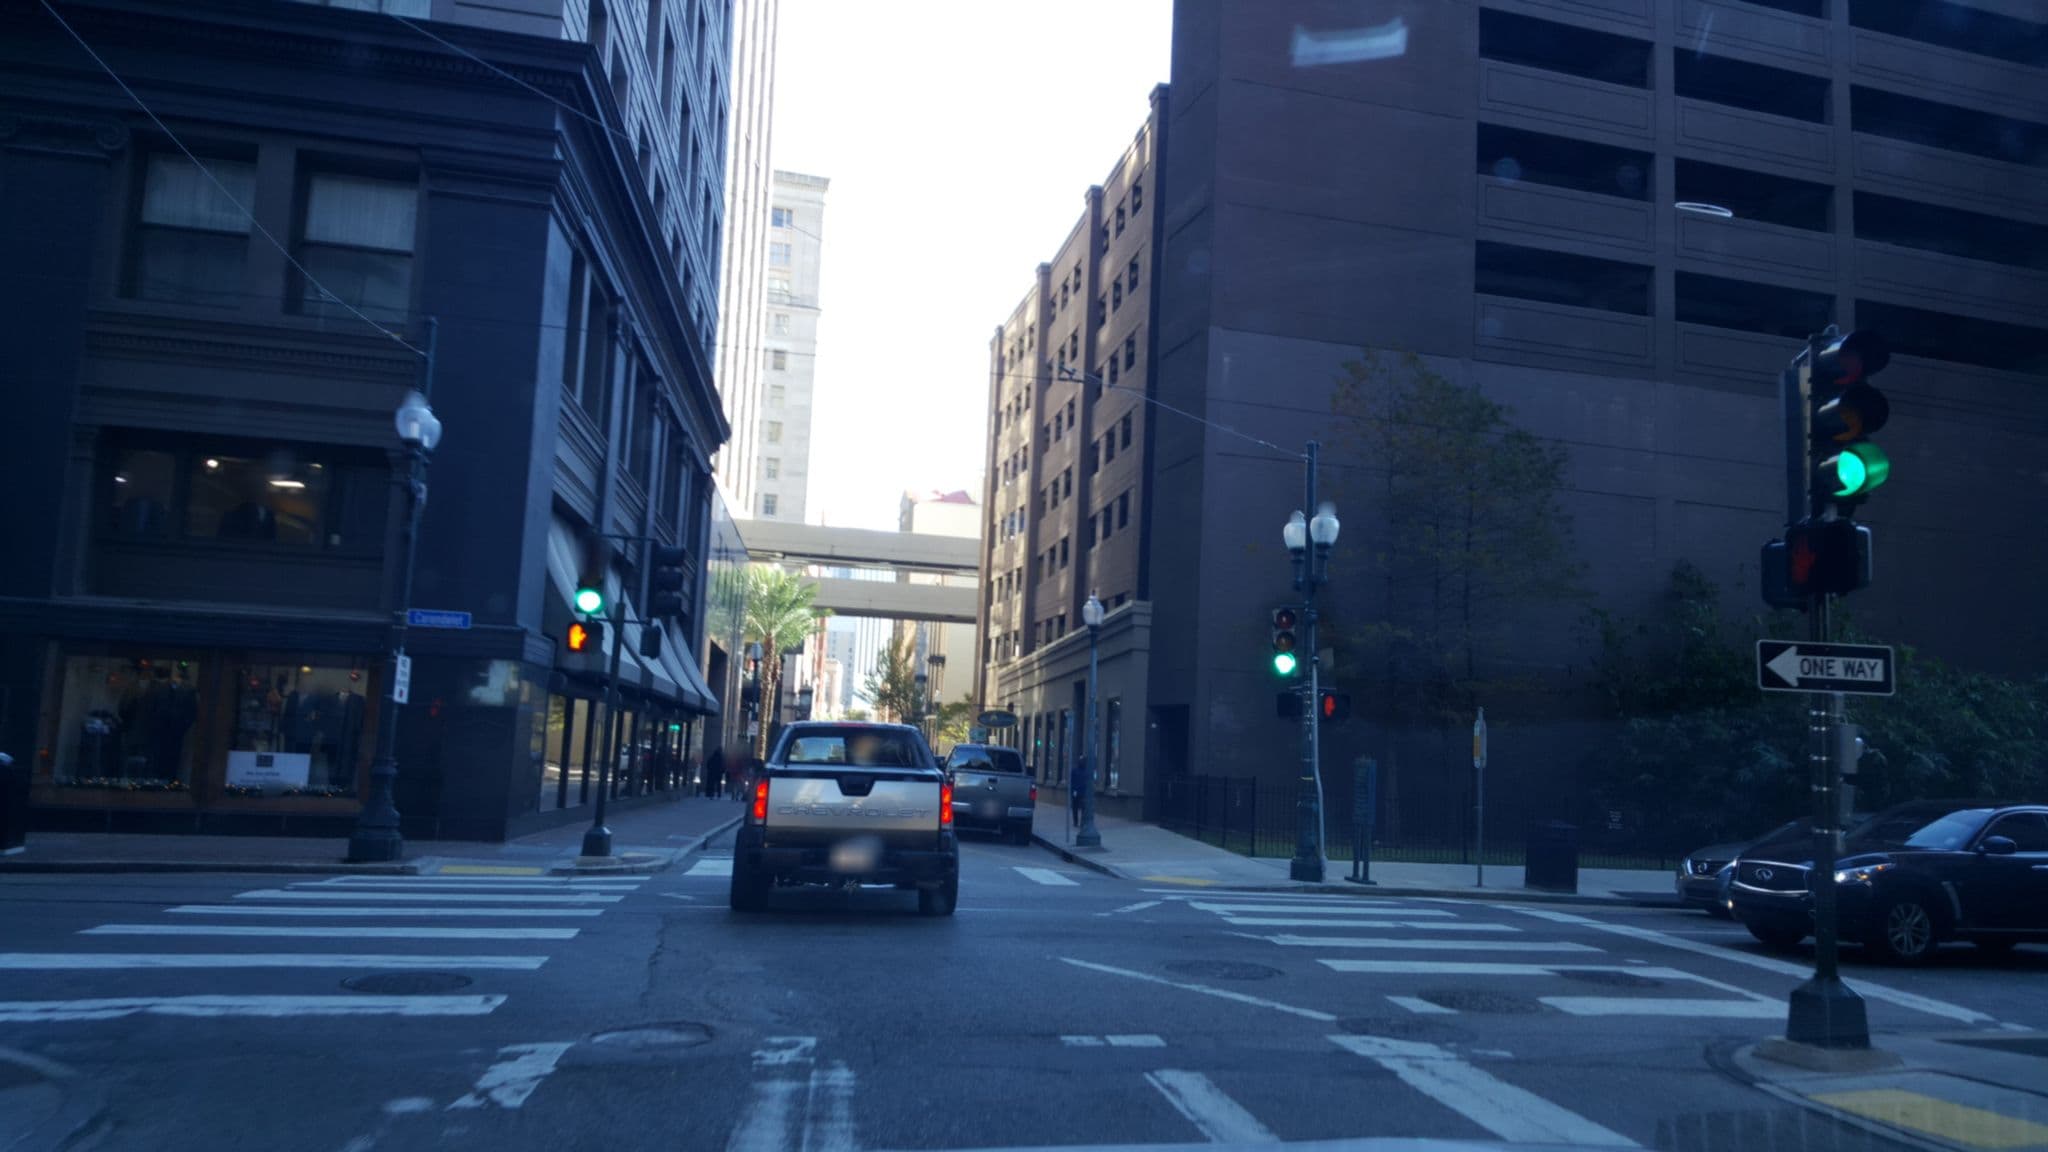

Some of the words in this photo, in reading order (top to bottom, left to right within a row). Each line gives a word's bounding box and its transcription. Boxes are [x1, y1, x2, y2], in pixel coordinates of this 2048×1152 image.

[1799, 657, 1838, 677] ONE
[1842, 660, 1879, 679] WAY
[776, 805, 932, 820] CHEVROLET
